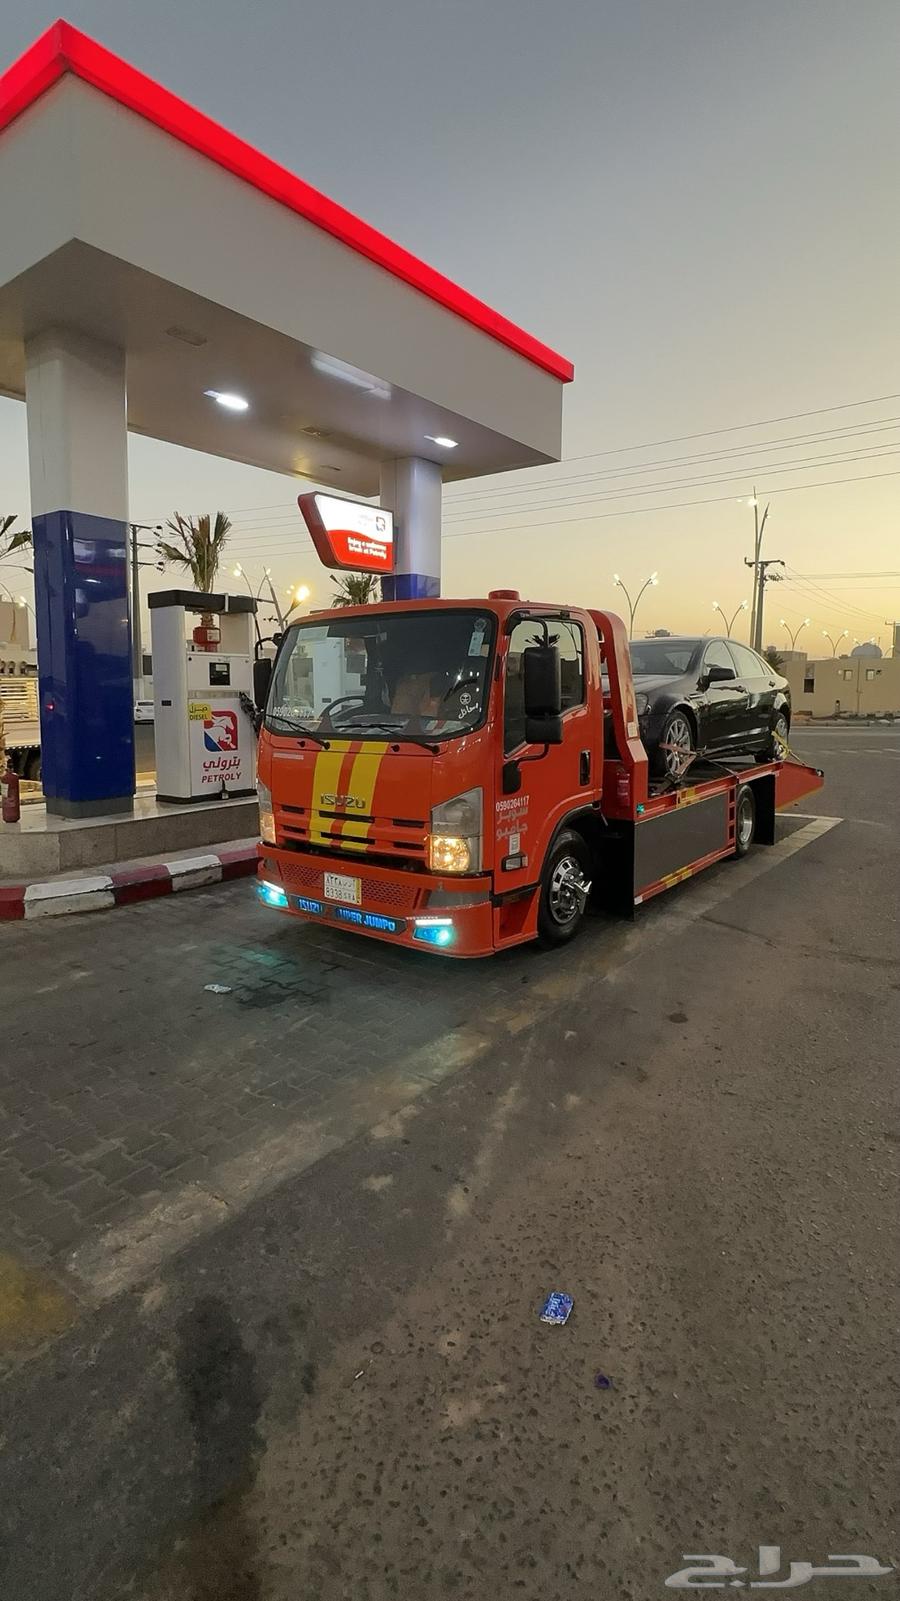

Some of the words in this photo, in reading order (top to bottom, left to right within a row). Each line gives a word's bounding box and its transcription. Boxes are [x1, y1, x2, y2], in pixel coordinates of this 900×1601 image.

[189, 713, 208, 721] DIESEL
[202, 772, 241, 783] PETROLY
[320, 794, 366, 809] ISUZU
